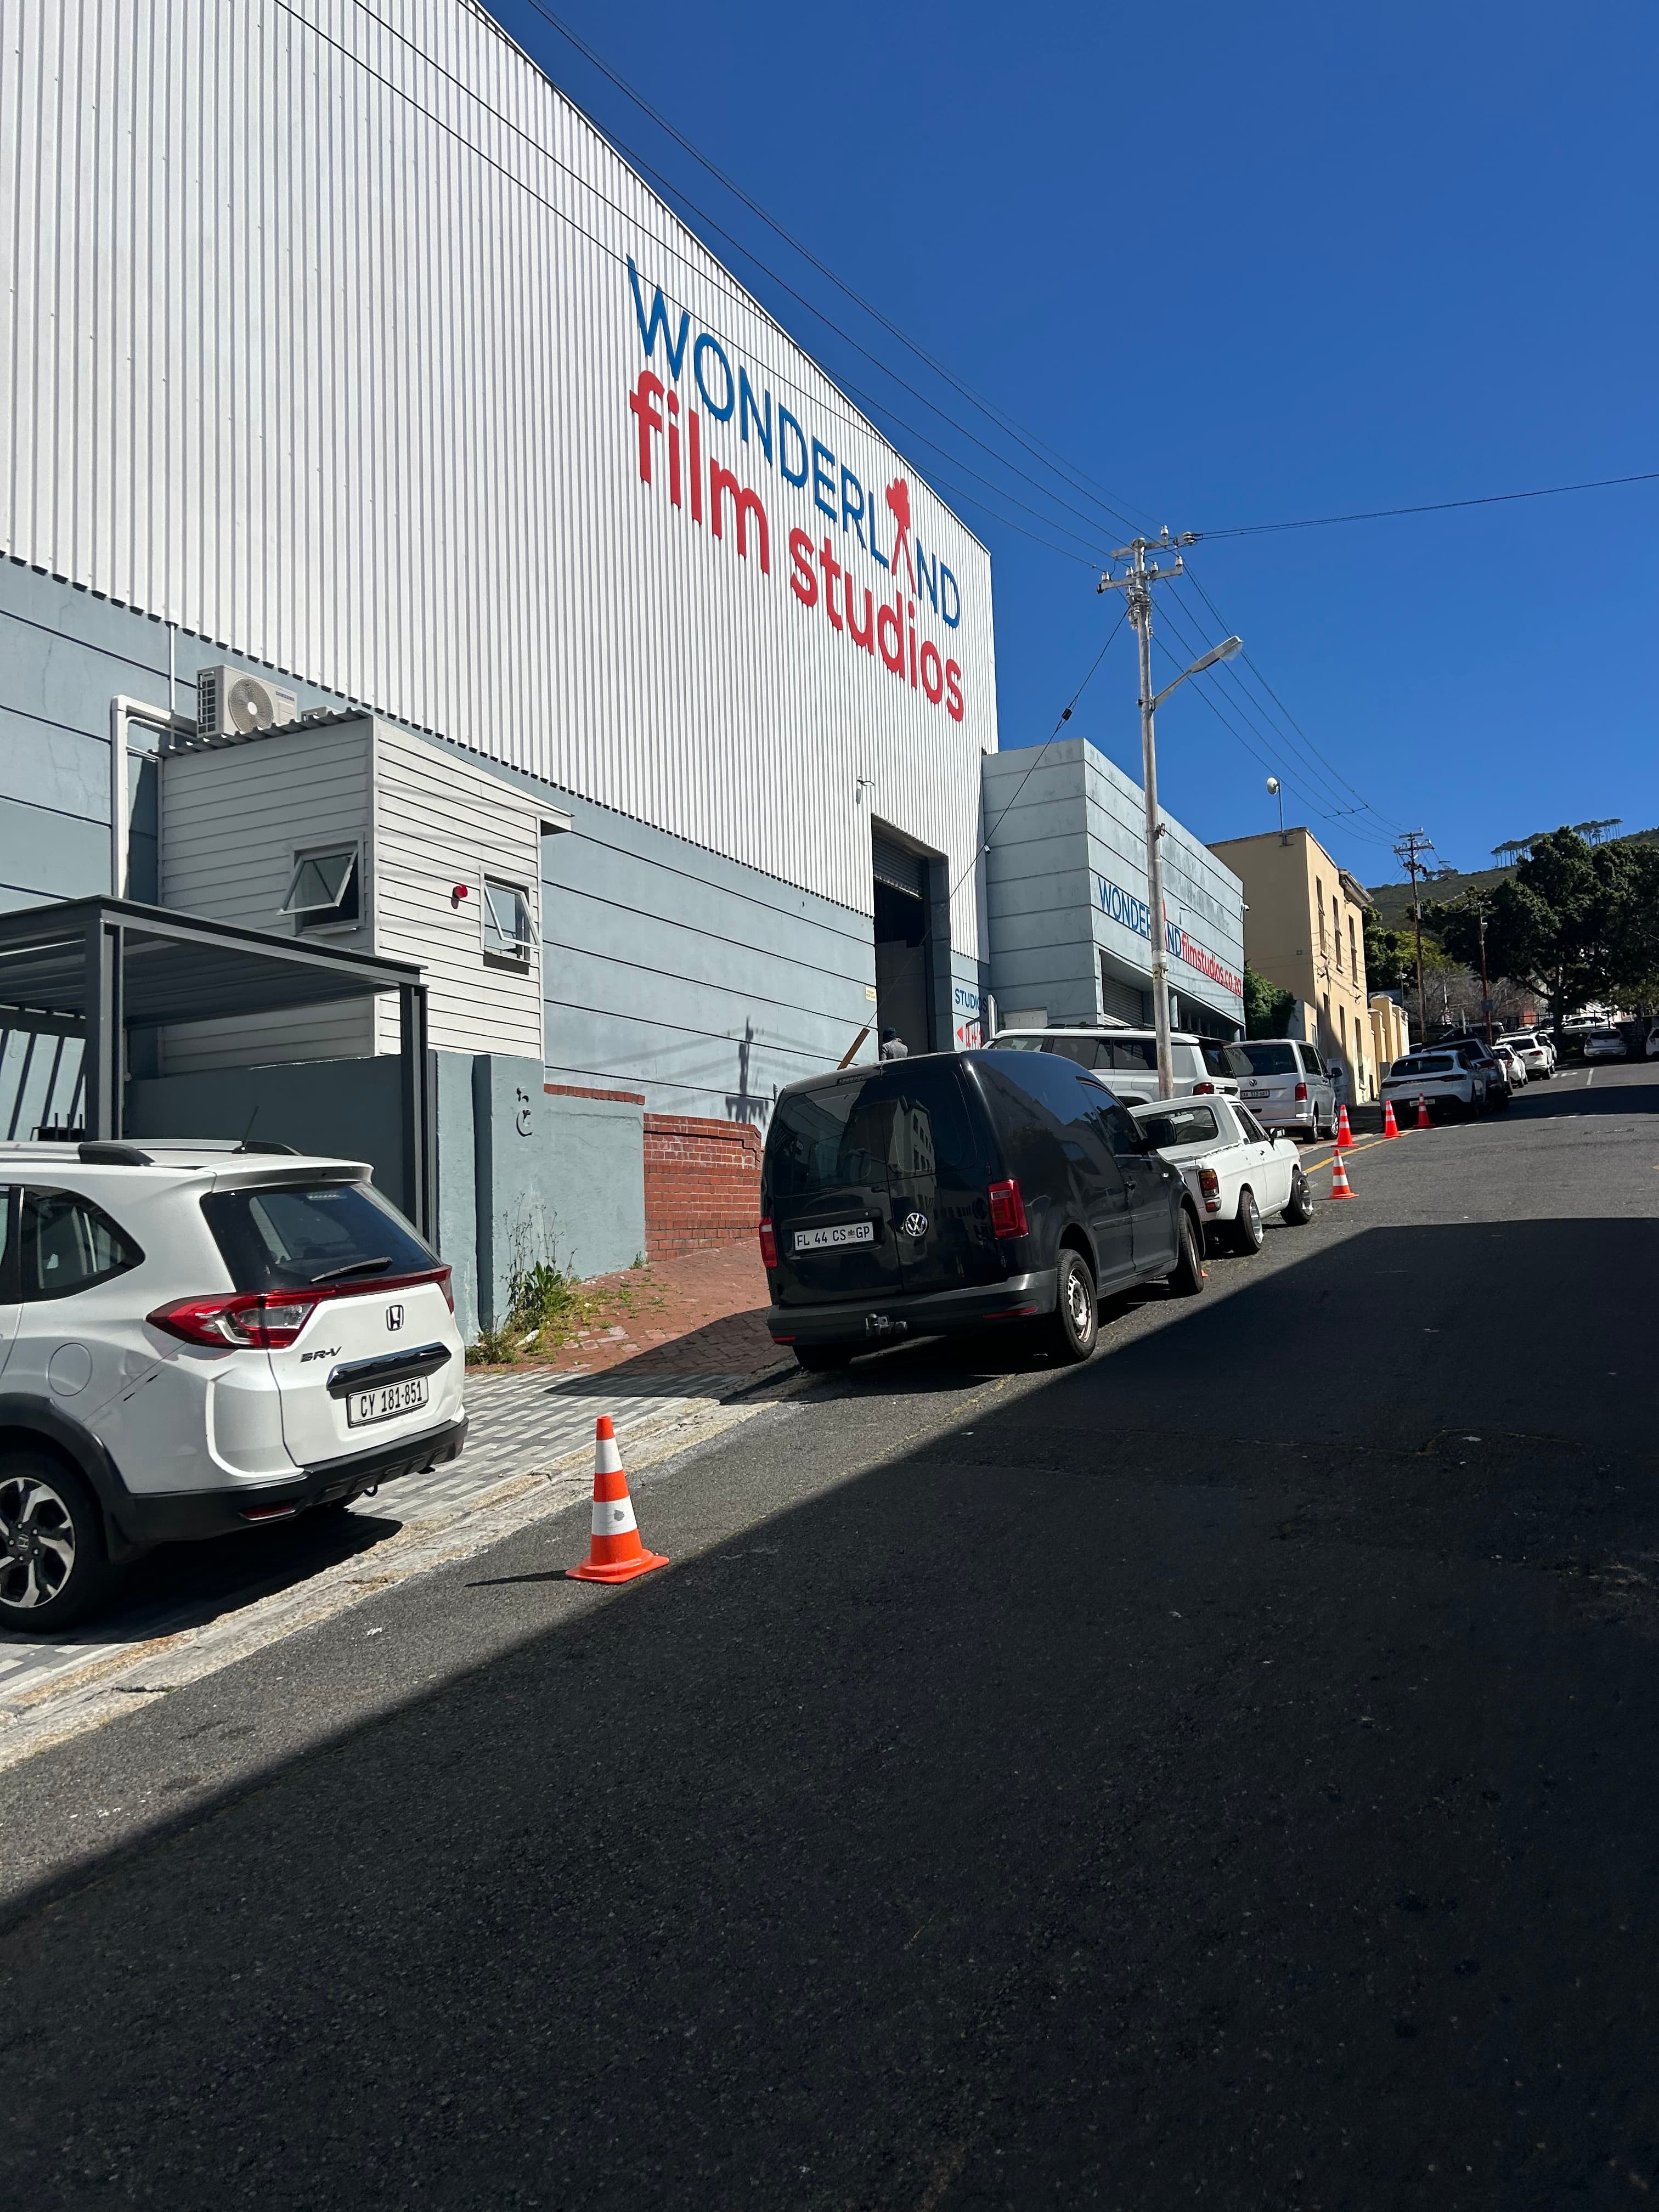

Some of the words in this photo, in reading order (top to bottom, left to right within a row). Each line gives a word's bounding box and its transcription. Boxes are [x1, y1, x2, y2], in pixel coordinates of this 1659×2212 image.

[630, 371, 770, 574] film
[789, 528, 964, 723] studios
[955, 988, 988, 1014] STUDIOS
[797, 1234, 810, 1246] FL
[815, 1232, 827, 1244] 44
[833, 1229, 846, 1242] CS
[856, 1226, 870, 1239] GP
[300, 1346, 342, 1363] BR-V
[360, 1392, 375, 1418] CY
[381, 1380, 423, 1413] 181-851
